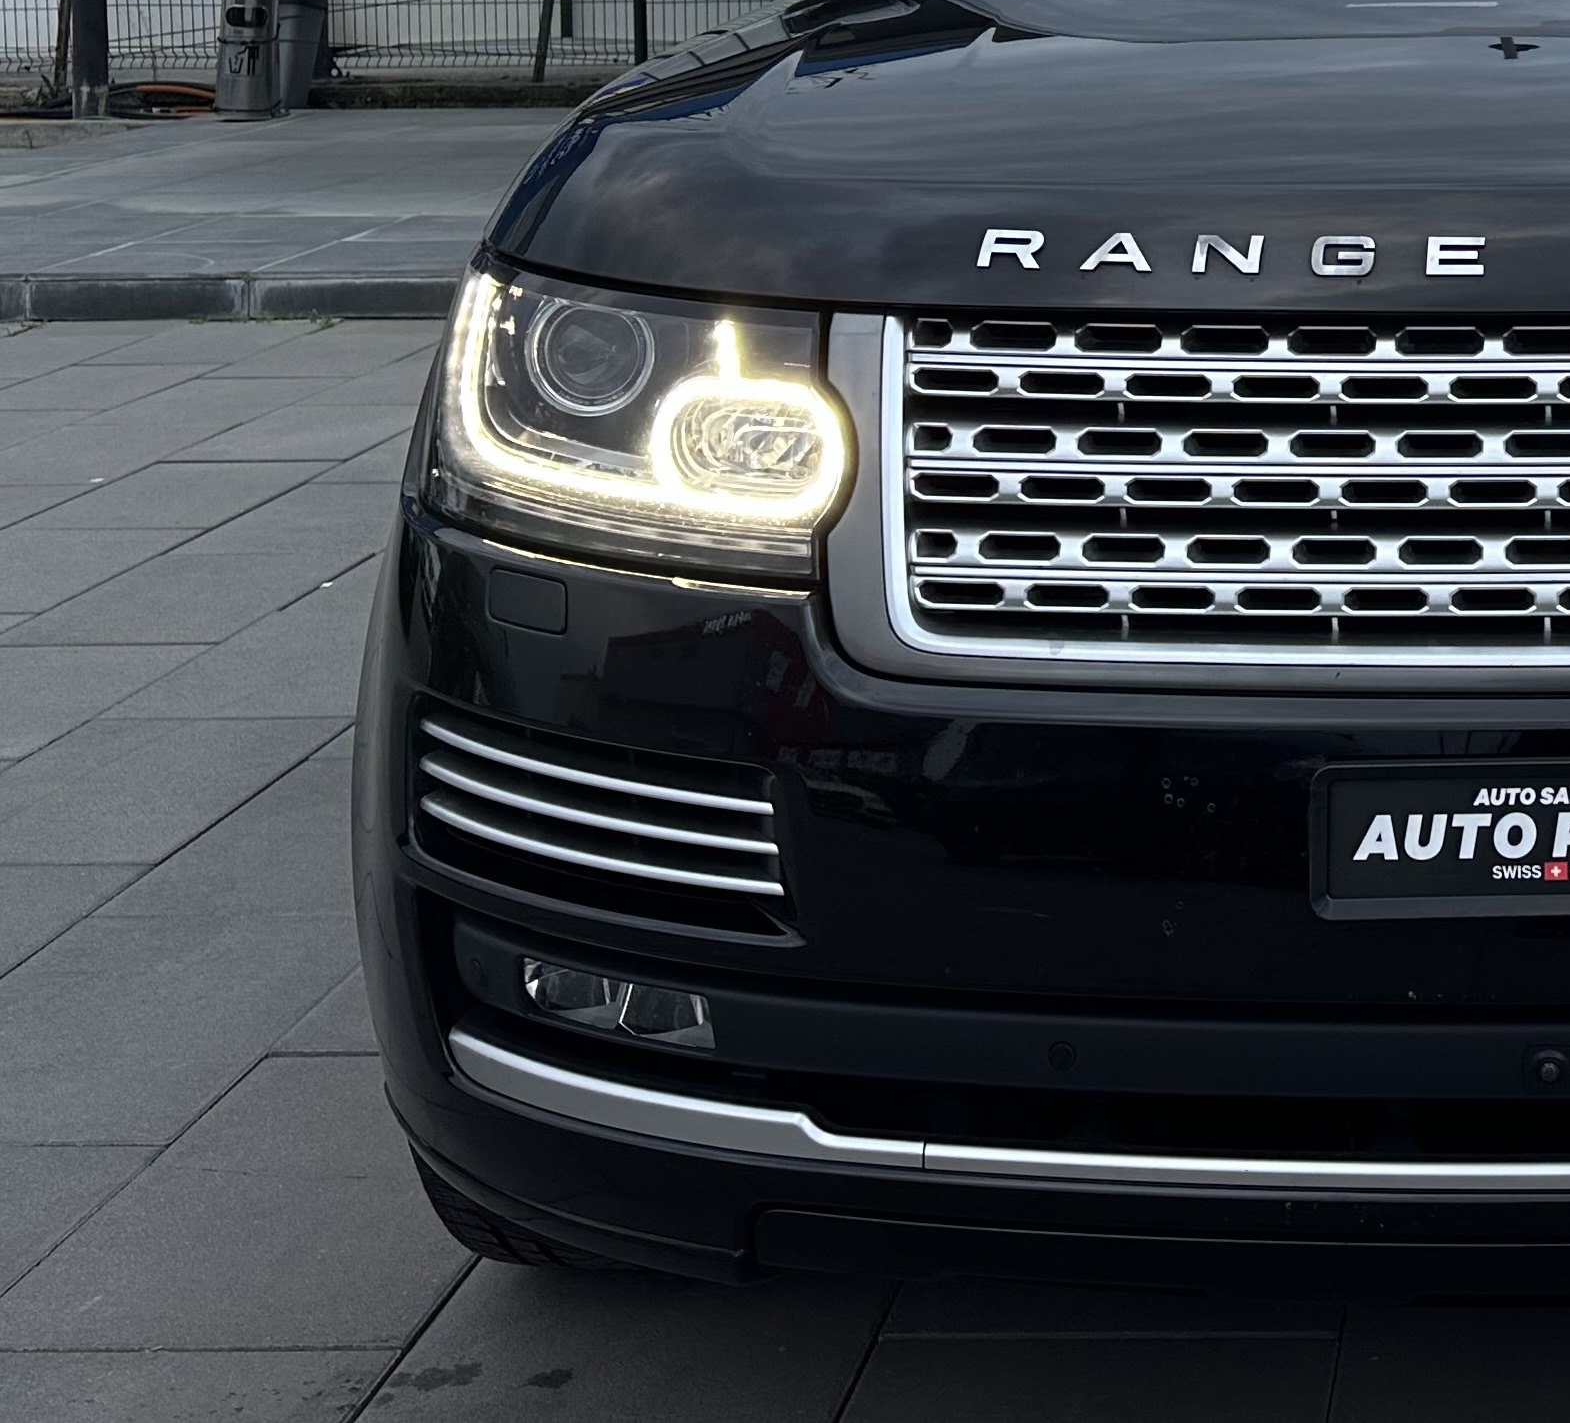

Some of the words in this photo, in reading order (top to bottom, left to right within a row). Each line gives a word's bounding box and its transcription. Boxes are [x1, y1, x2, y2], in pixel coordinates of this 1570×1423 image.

[975, 228, 1487, 276] RANGE
[1473, 786, 1537, 807] AUTO
[1353, 812, 1537, 861] AUTO
[1492, 863, 1542, 880] SWISS
